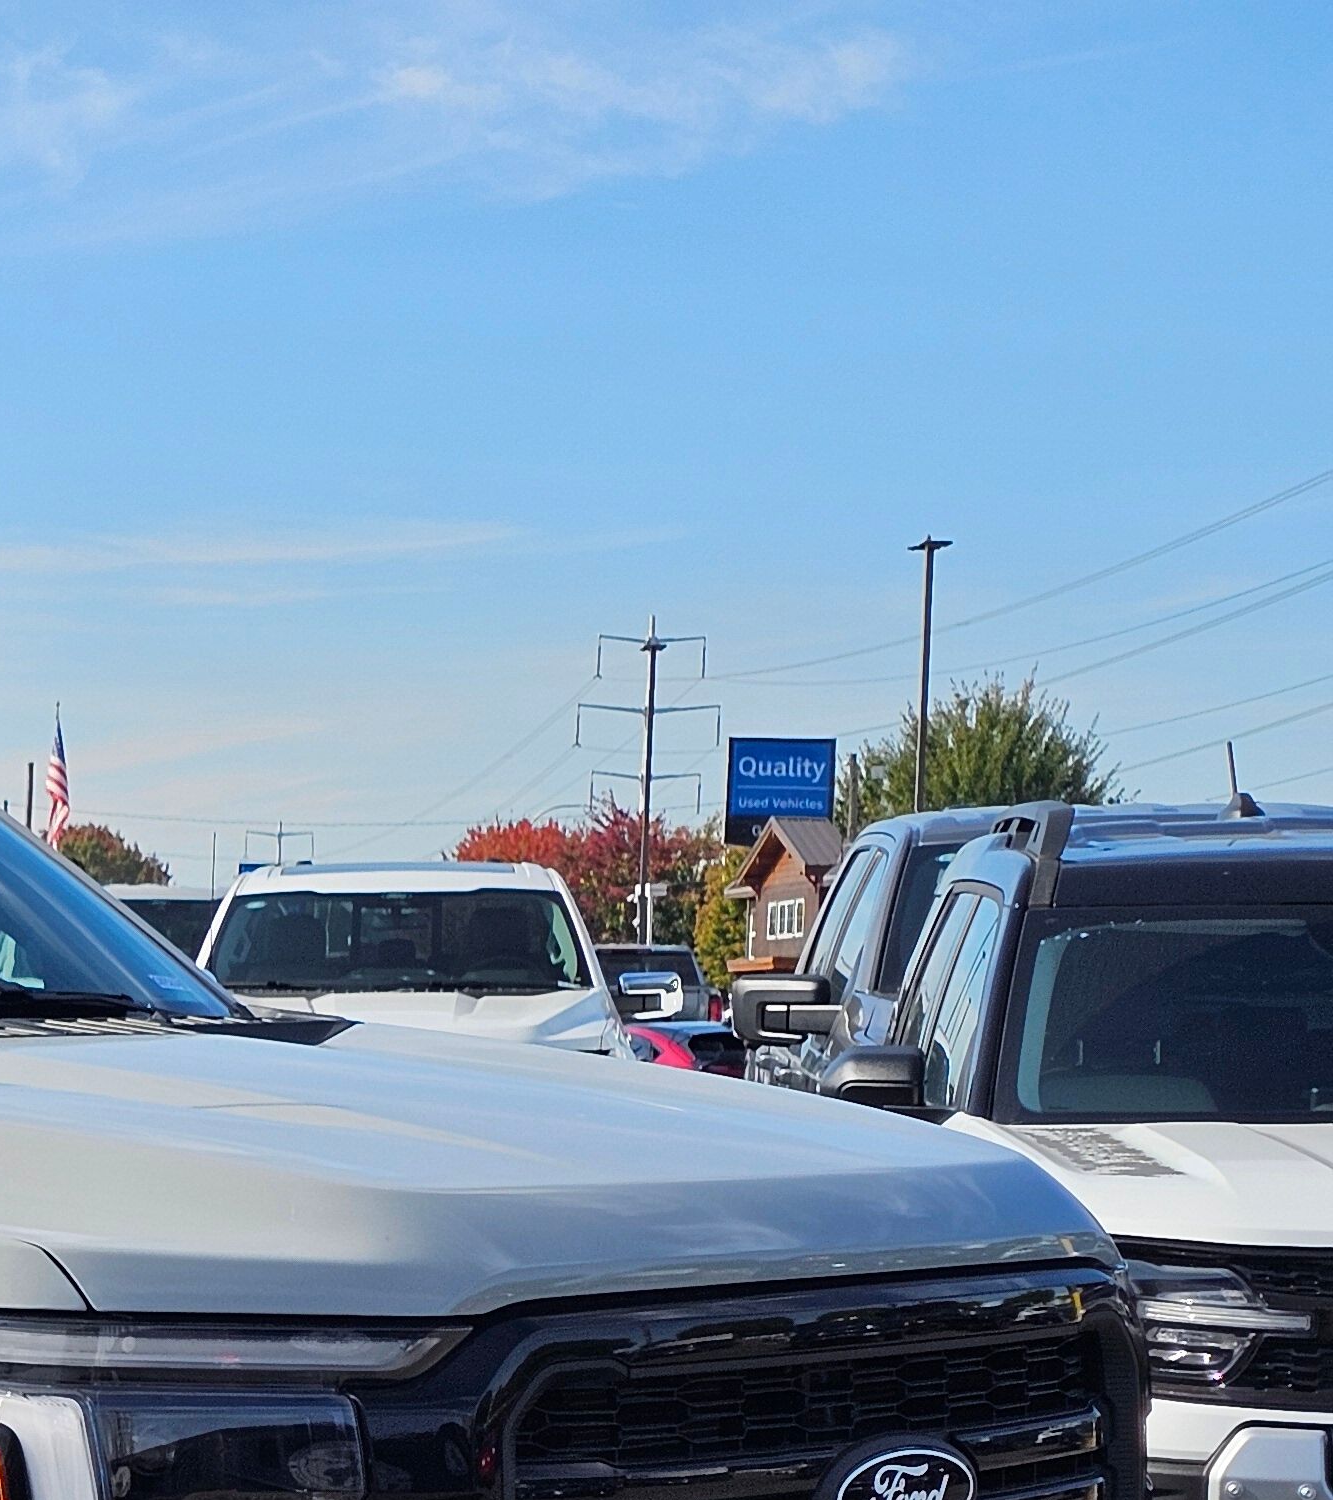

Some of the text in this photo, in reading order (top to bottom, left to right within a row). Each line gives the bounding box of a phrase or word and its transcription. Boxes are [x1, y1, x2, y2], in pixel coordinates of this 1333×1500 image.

[738, 756, 826, 783] Quality
[738, 797, 824, 810] Used Vehicles
